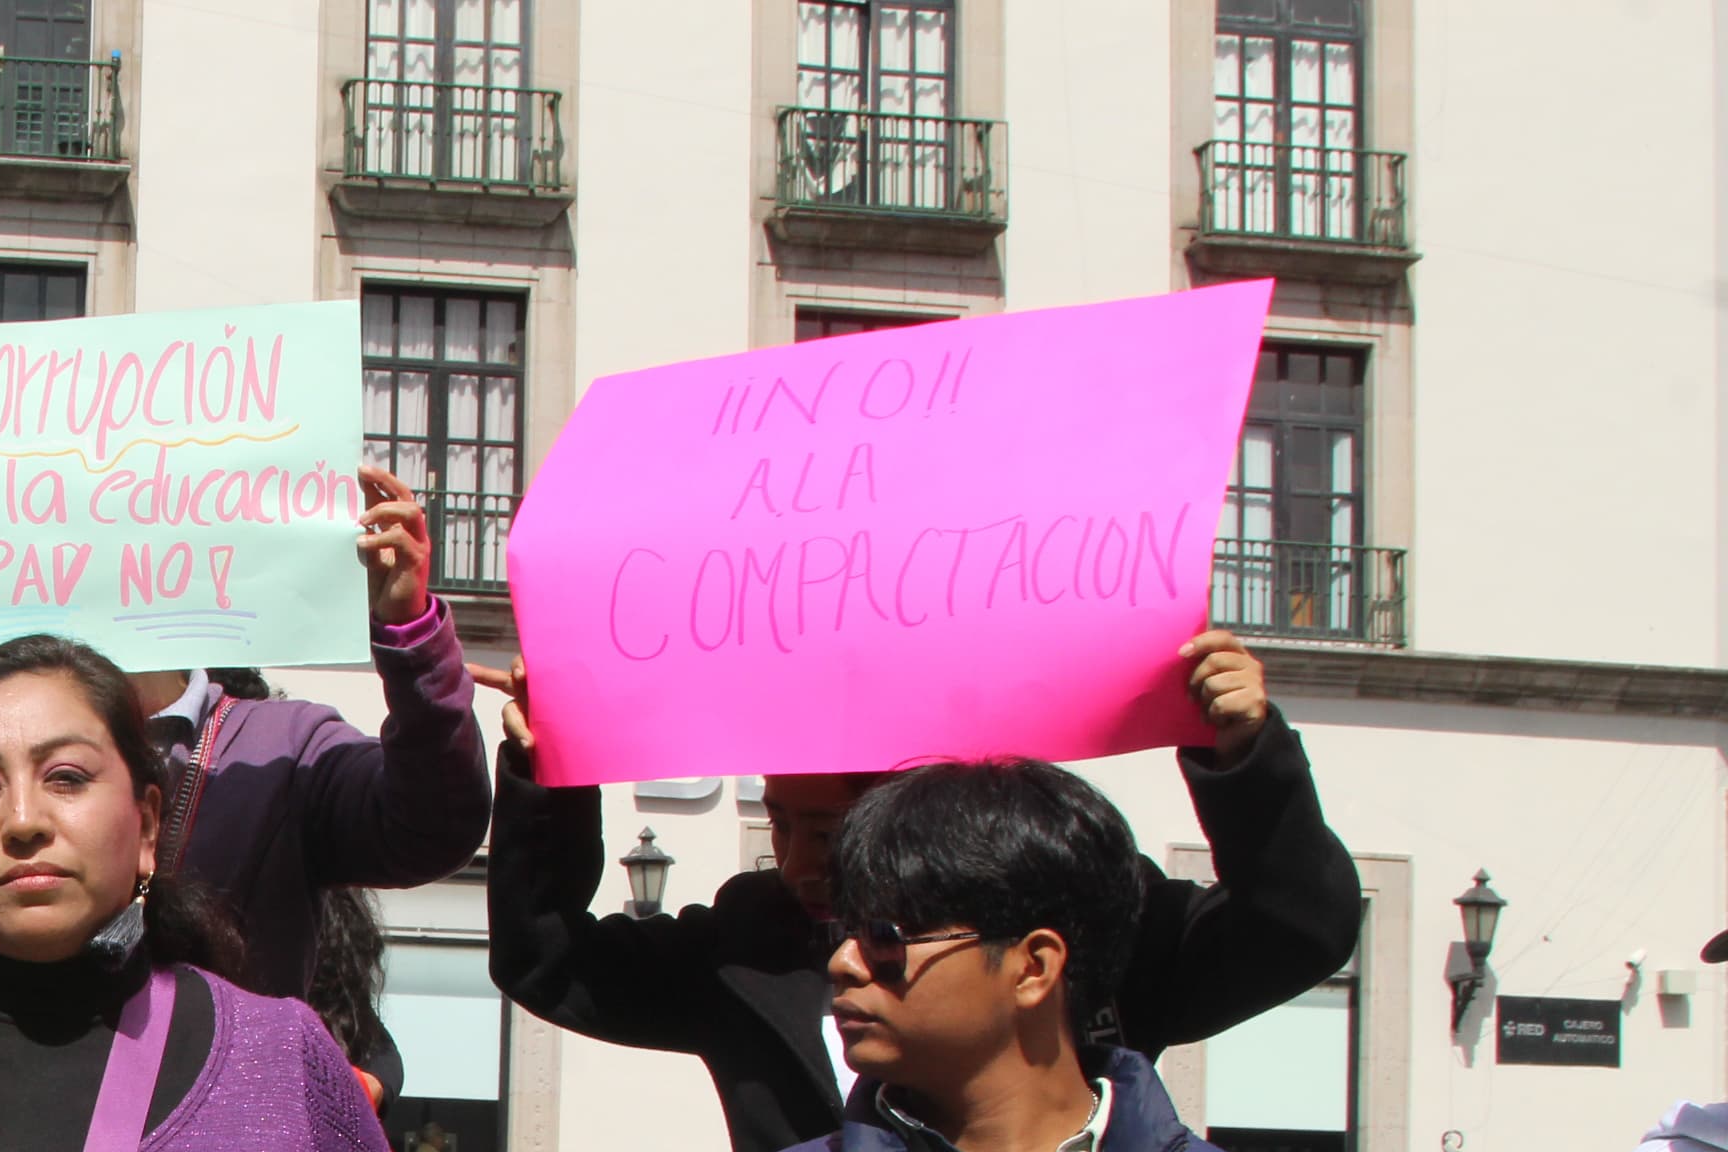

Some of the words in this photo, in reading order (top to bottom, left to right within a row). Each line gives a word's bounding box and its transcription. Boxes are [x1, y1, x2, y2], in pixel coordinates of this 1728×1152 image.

[6, 459, 68, 527] la
[88, 444, 360, 529] educación
[608, 501, 1192, 662] COMPACTACION
[1516, 1022, 1546, 1036] RED
[1563, 1019, 1604, 1030] CAJERO
